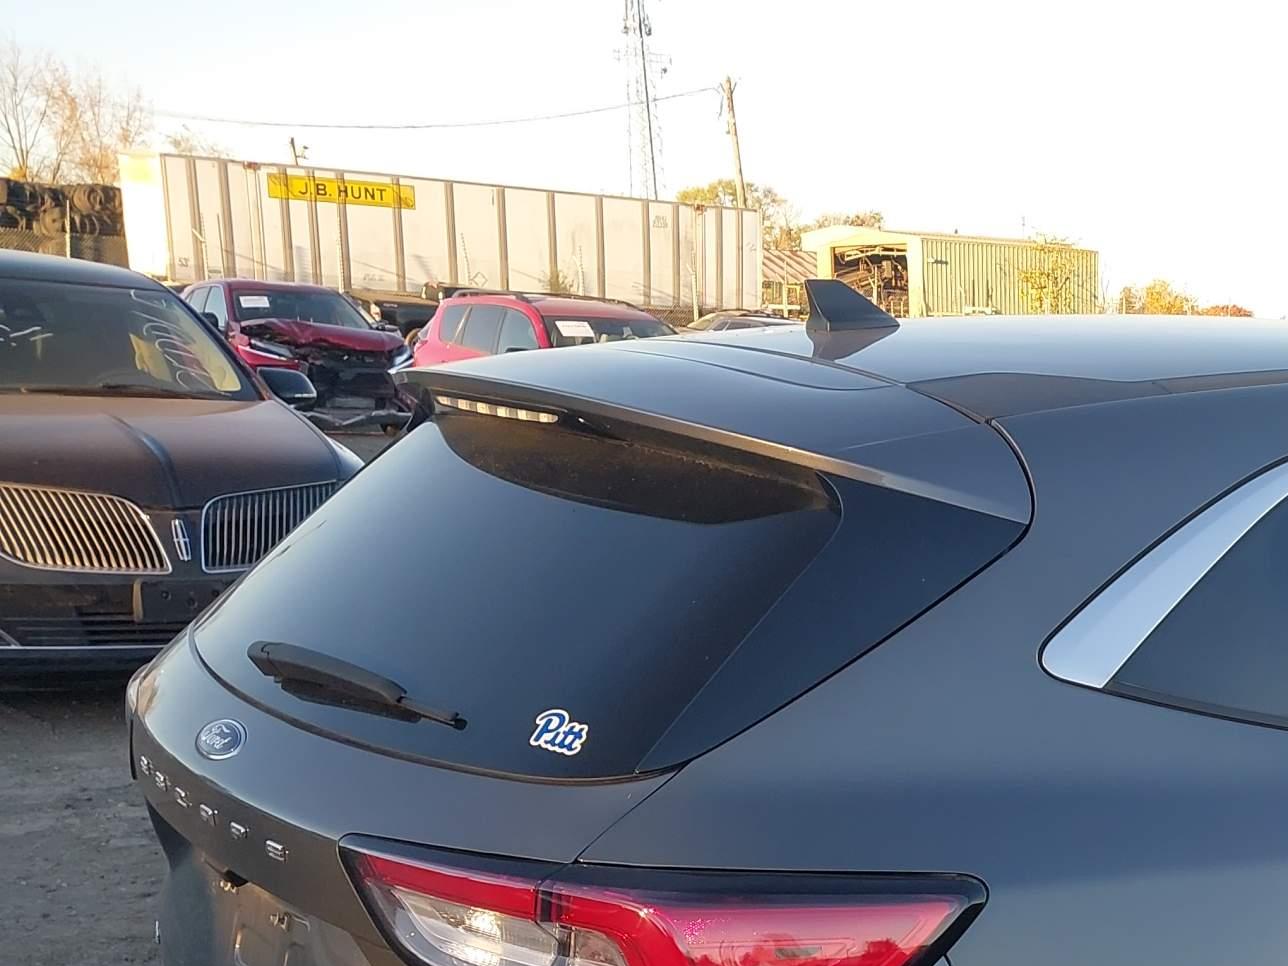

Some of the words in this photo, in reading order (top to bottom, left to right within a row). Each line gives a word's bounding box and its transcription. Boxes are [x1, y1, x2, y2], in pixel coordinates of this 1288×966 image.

[299, 181, 332, 197] J.B.
[338, 183, 387, 201] HUNT
[529, 709, 589, 756] Pitt
